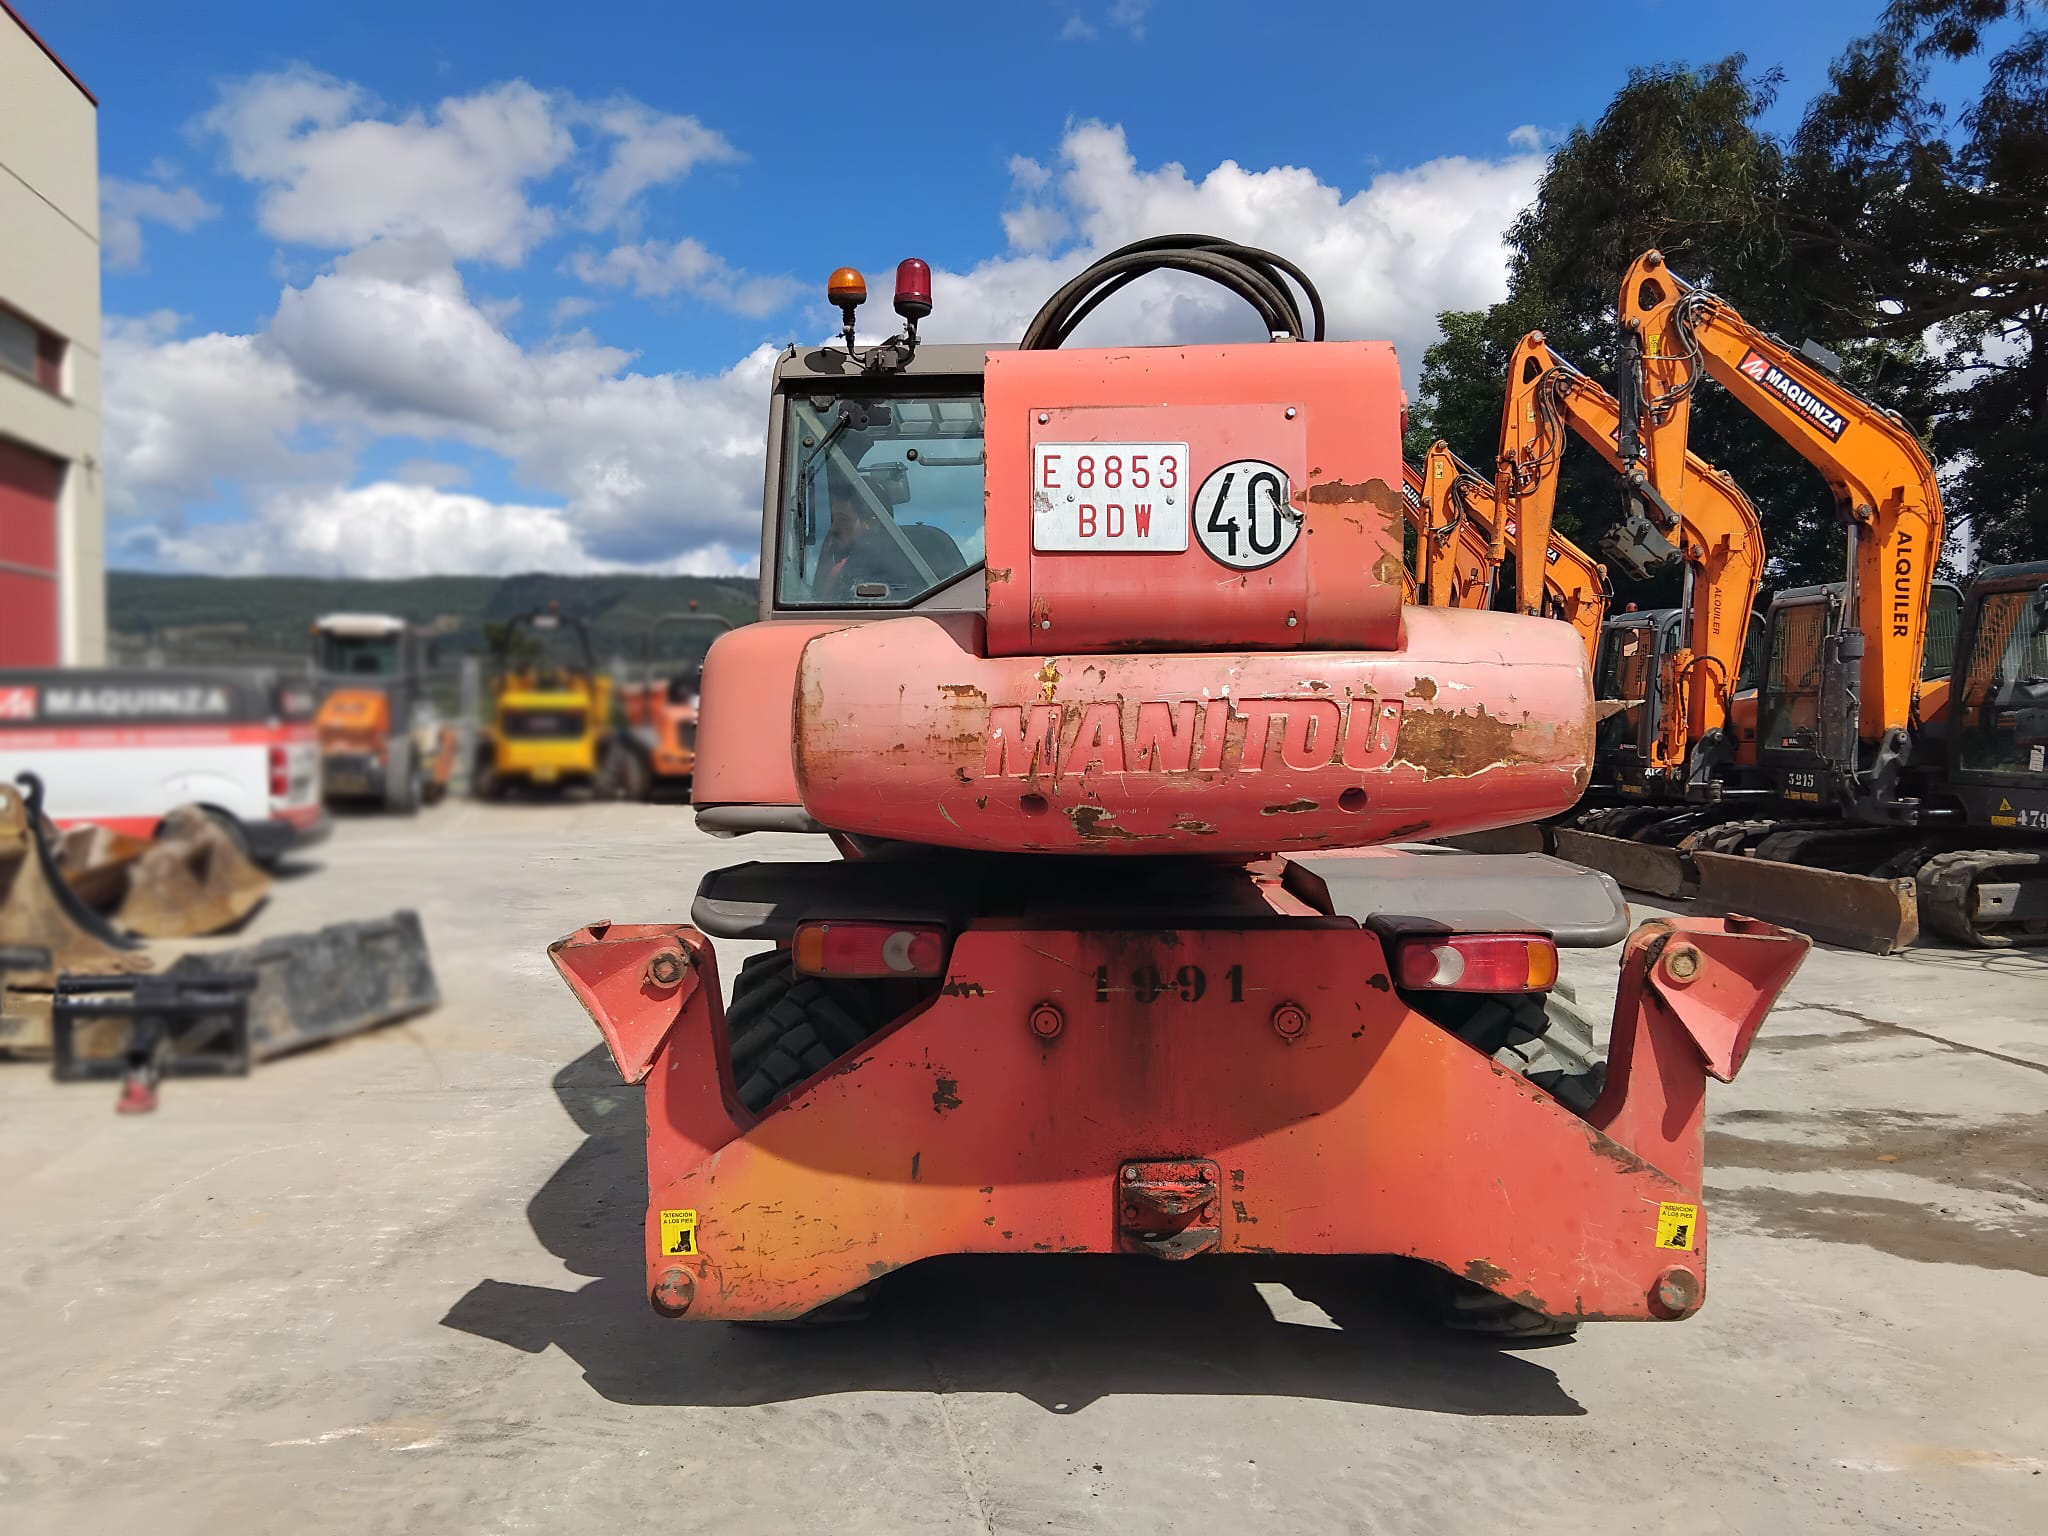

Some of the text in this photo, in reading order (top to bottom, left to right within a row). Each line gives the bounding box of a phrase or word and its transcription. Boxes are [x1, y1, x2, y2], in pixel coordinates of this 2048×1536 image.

[1765, 368, 1842, 433] MAQUINZA
[1077, 455, 1178, 489] 8853
[1079, 504, 1152, 538] BDW
[1207, 471, 1282, 557] 40
[1892, 530, 1913, 638] ALQUILER
[46, 687, 229, 717] MAQUINZA
[983, 697, 1405, 779] MANITOU
[1096, 964, 1245, 1003] 1991
